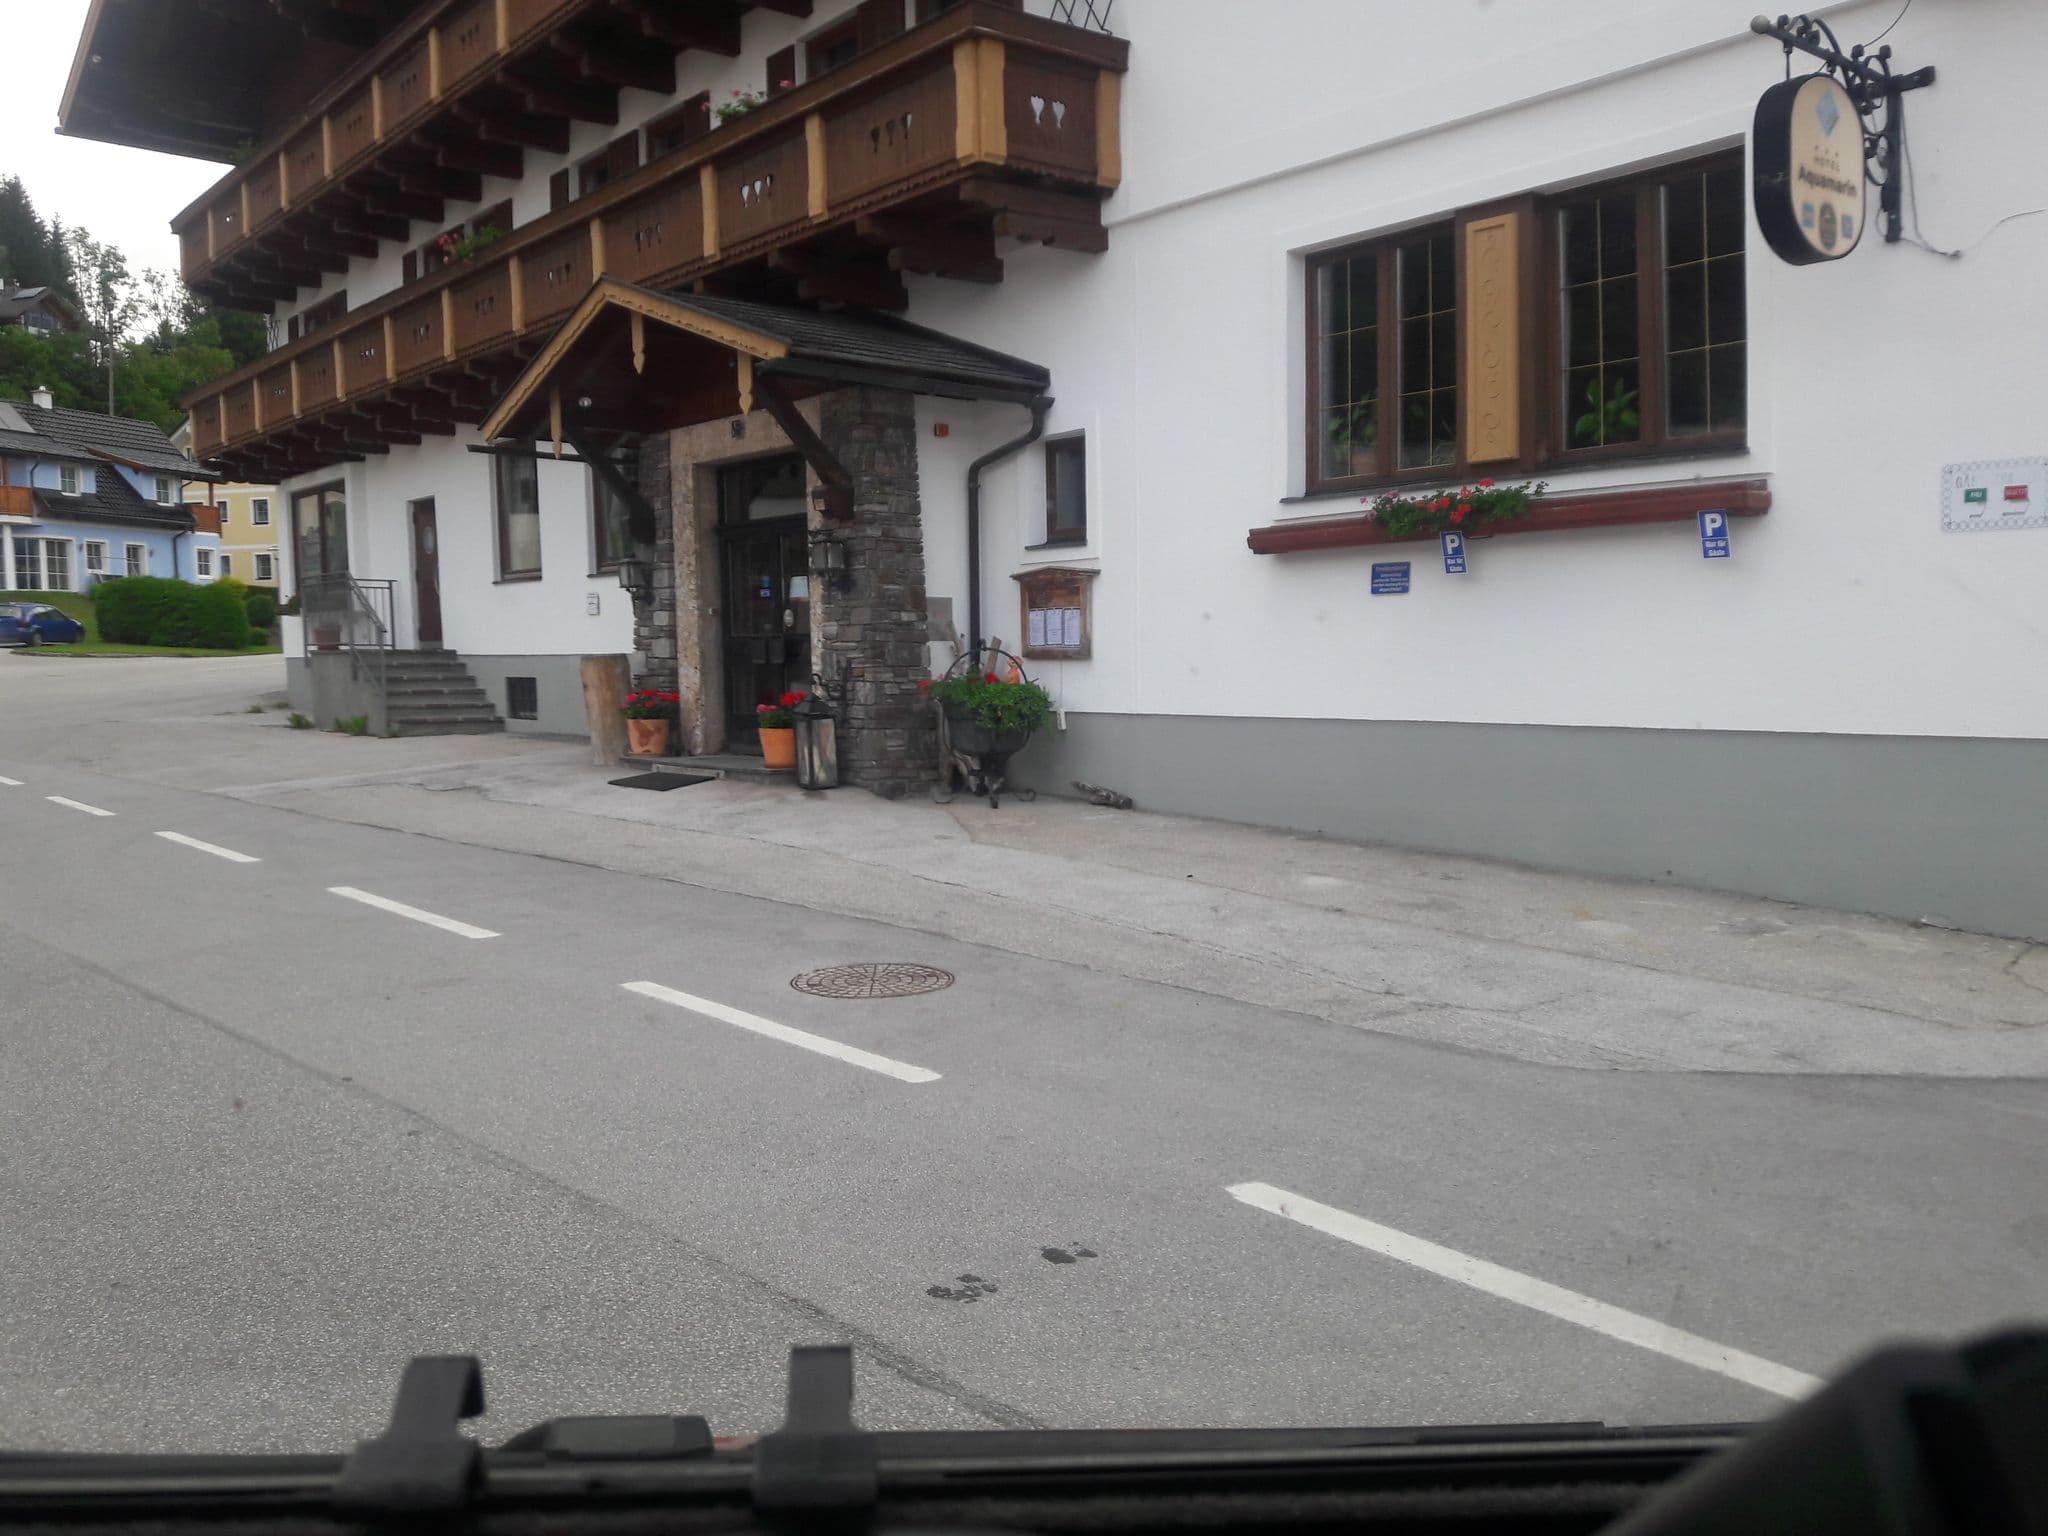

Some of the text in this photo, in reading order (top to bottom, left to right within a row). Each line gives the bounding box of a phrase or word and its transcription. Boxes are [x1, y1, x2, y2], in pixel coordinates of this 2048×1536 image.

[1813, 156, 1841, 172] HOTEL
[1799, 165, 1857, 197] Aquamarin
[1704, 513, 1723, 536] P
[1445, 534, 1460, 555] P
